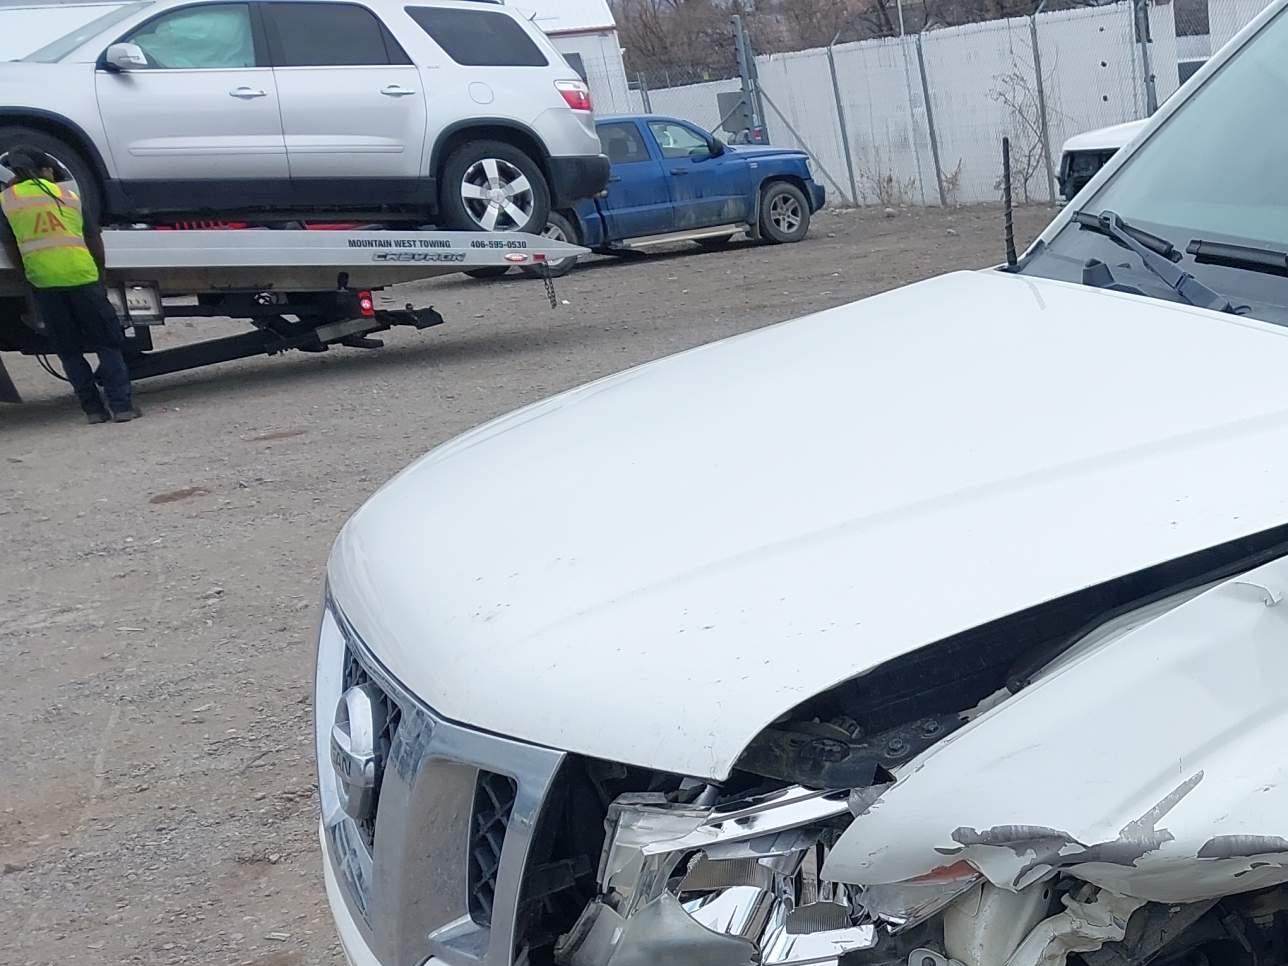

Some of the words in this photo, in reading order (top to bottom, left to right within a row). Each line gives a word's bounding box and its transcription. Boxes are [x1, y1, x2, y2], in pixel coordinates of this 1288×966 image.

[347, 239, 392, 249] MOUNTAIN
[393, 239, 417, 249] WEST
[417, 239, 452, 249] TOWING
[470, 239, 528, 249] 406-595-0530
